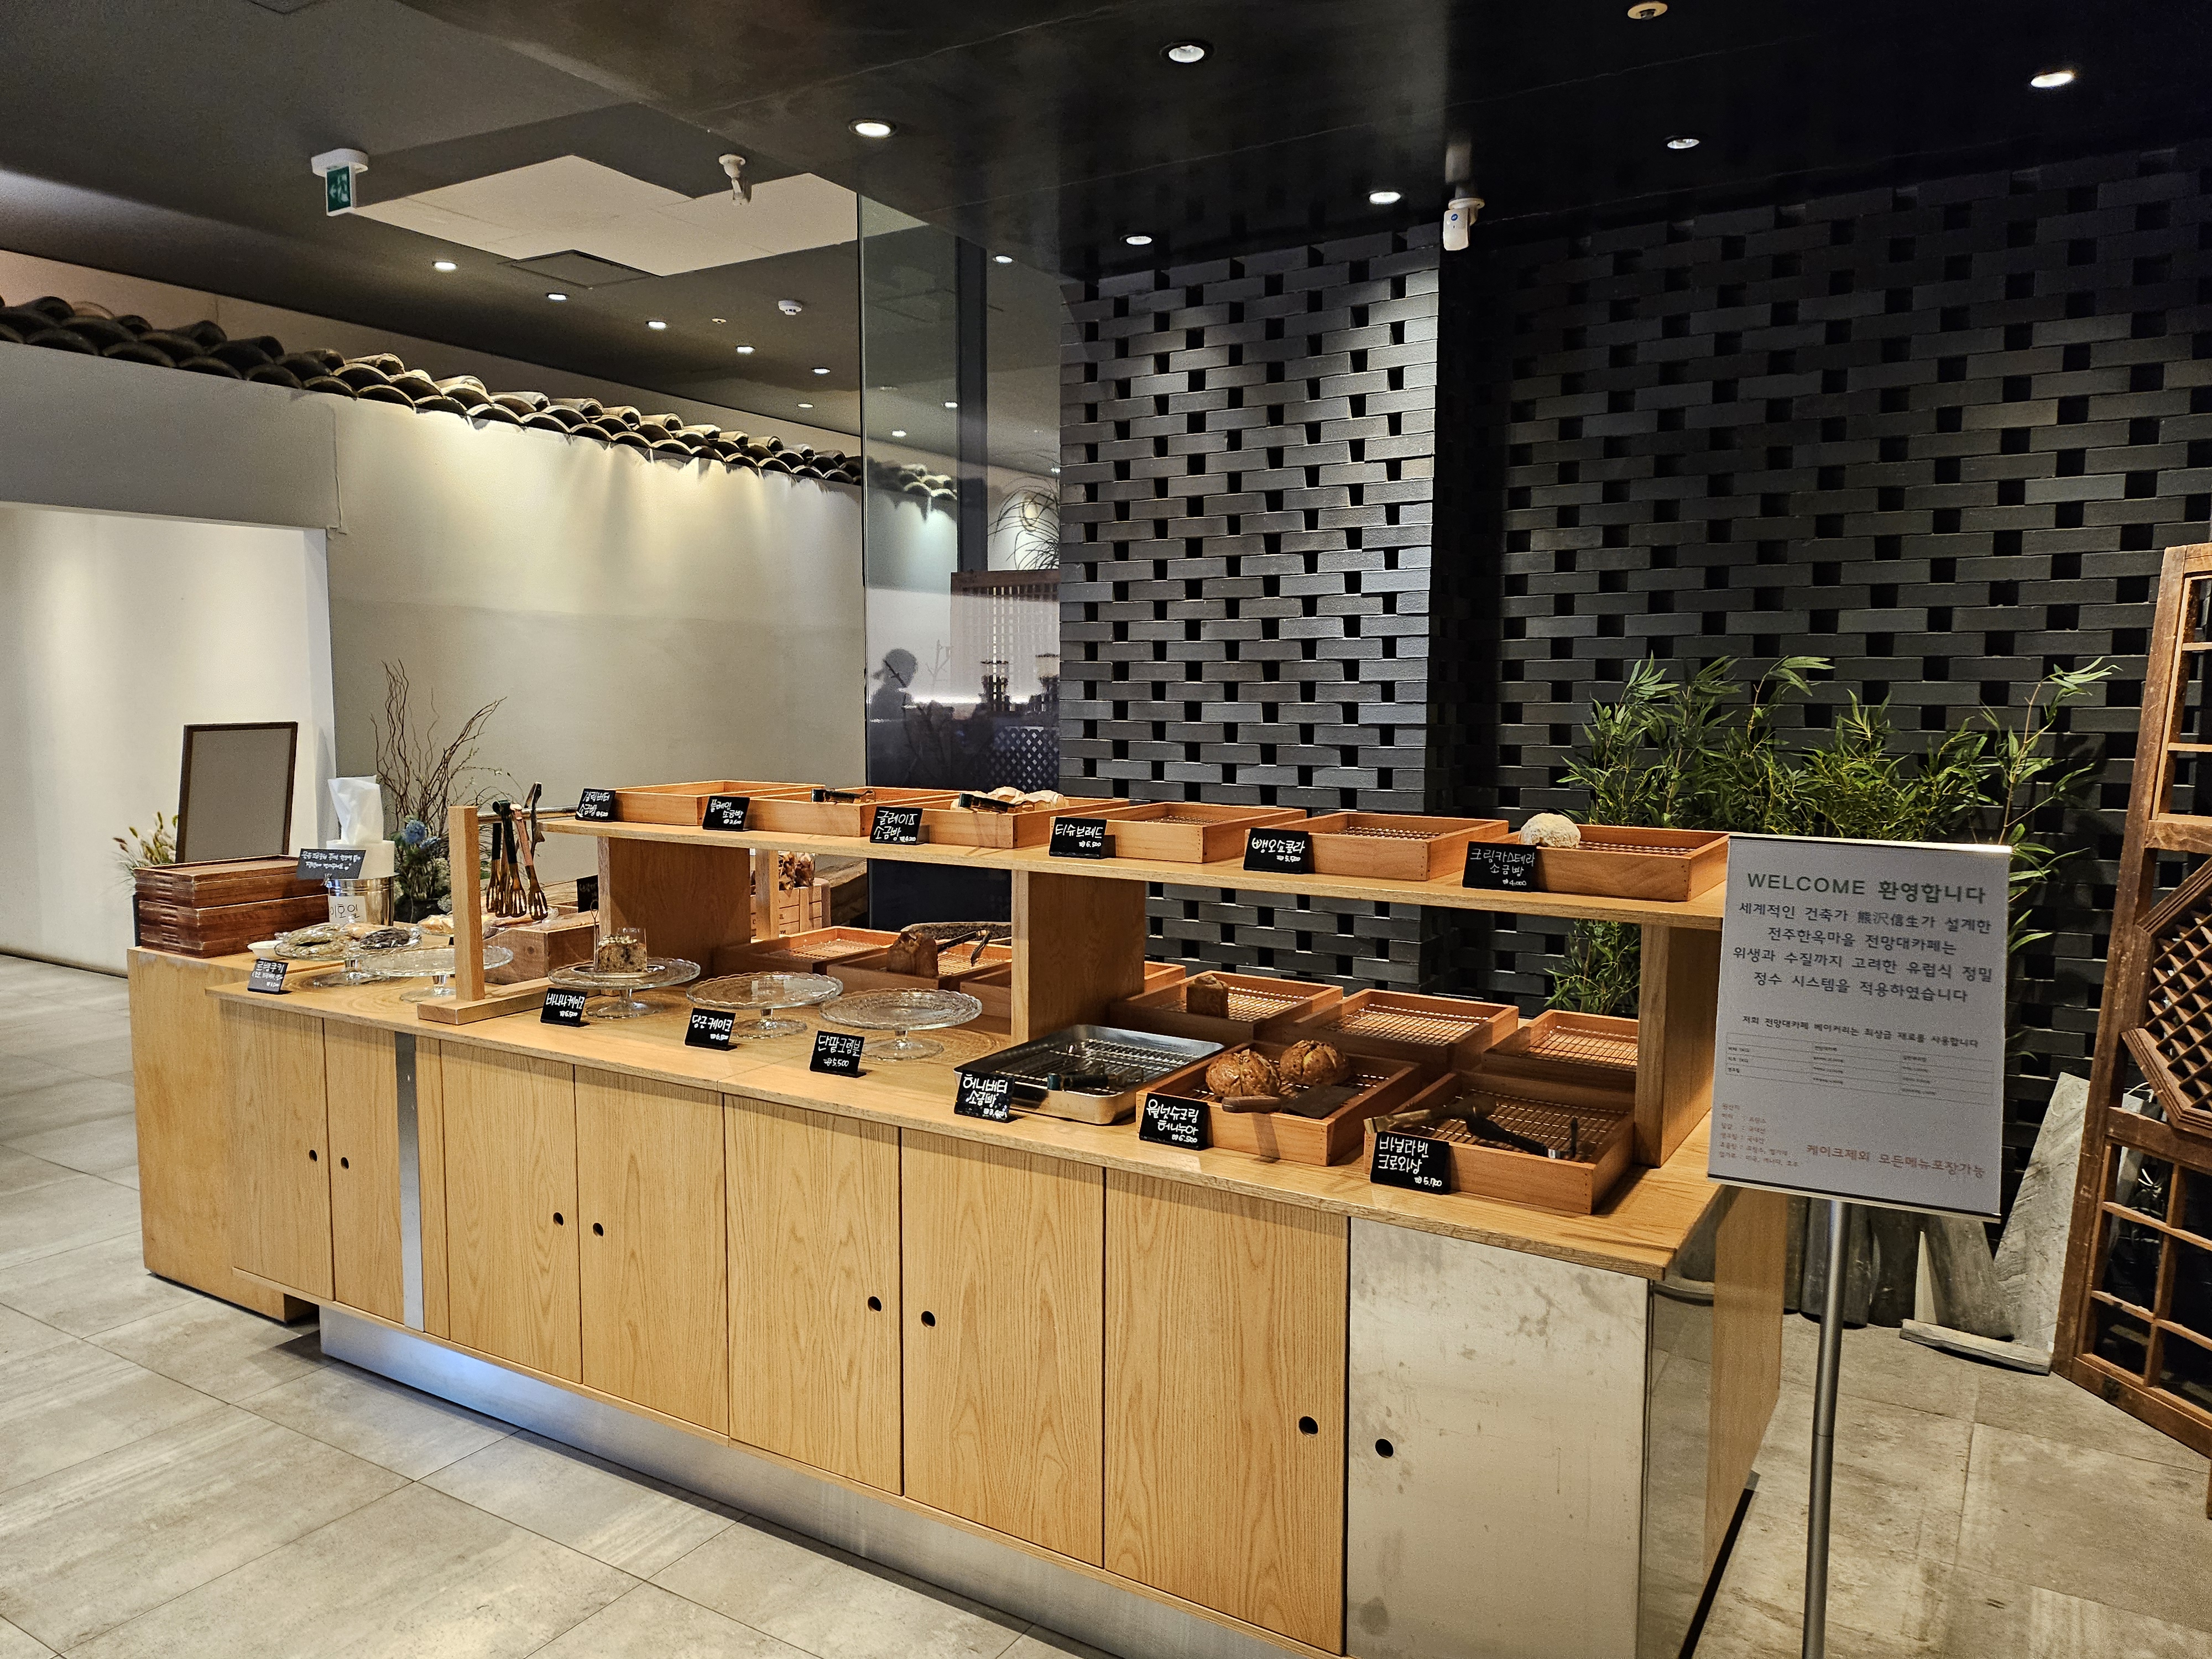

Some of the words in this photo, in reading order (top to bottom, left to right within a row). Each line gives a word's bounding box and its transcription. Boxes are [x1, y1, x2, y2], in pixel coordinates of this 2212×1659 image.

[722, 810, 744, 818] 소금빵
[877, 810, 918, 825] 글레이즈
[874, 826, 901, 841] 소금빵
[1055, 824, 1103, 838] 티슈브레드
[1251, 837, 1305, 853] 뺑오쇼콜라
[1470, 848, 1535, 867] 크림카스테라
[1490, 863, 1524, 877] 소금빵
[1747, 873, 1865, 895] WELCOME
[1879, 880, 1986, 904] 환영합니다
[1739, 902, 1795, 919] 세계적인
[1805, 907, 1849, 922] 건축가
[1944, 917, 1992, 935] 설계한
[1768, 927, 1855, 947] 전주한옥마을
[1865, 935, 1957, 956] 전망대카페는
[1733, 947, 1776, 963] 위생과
[1784, 952, 1842, 967] 수질까지
[1852, 957, 1897, 974] 고려한
[1906, 962, 1952, 979] 유럽식
[1963, 966, 1992, 983] 정밀
[1754, 972, 1782, 986] 정수
[1792, 975, 1850, 993] 시스템을
[1860, 981, 1968, 1002] 적용하였습니다
[546, 993, 585, 1009] 바나나케이크
[1743, 1016, 1759, 1024] 저희
[1765, 1018, 1808, 1030] 전망대카페
[1814, 1024, 1859, 1036] 베이커리는
[1864, 1029, 1891, 1040] 최상급
[1931, 1036, 1979, 1048] 사용합니다
[818, 1035, 861, 1057] 단팥크럼블
[963, 1074, 1008, 1094] 허니버터
[966, 1090, 997, 1108] 소금빵
[1146, 1099, 1199, 1123] 월넛슈크림
[1157, 1120, 1198, 1135] 허니누아
[1379, 1136, 1428, 1158] 바닐라빈
[1806, 1145, 1870, 1161] 케이크제외
[1378, 1154, 1422, 1174] 크로와상
